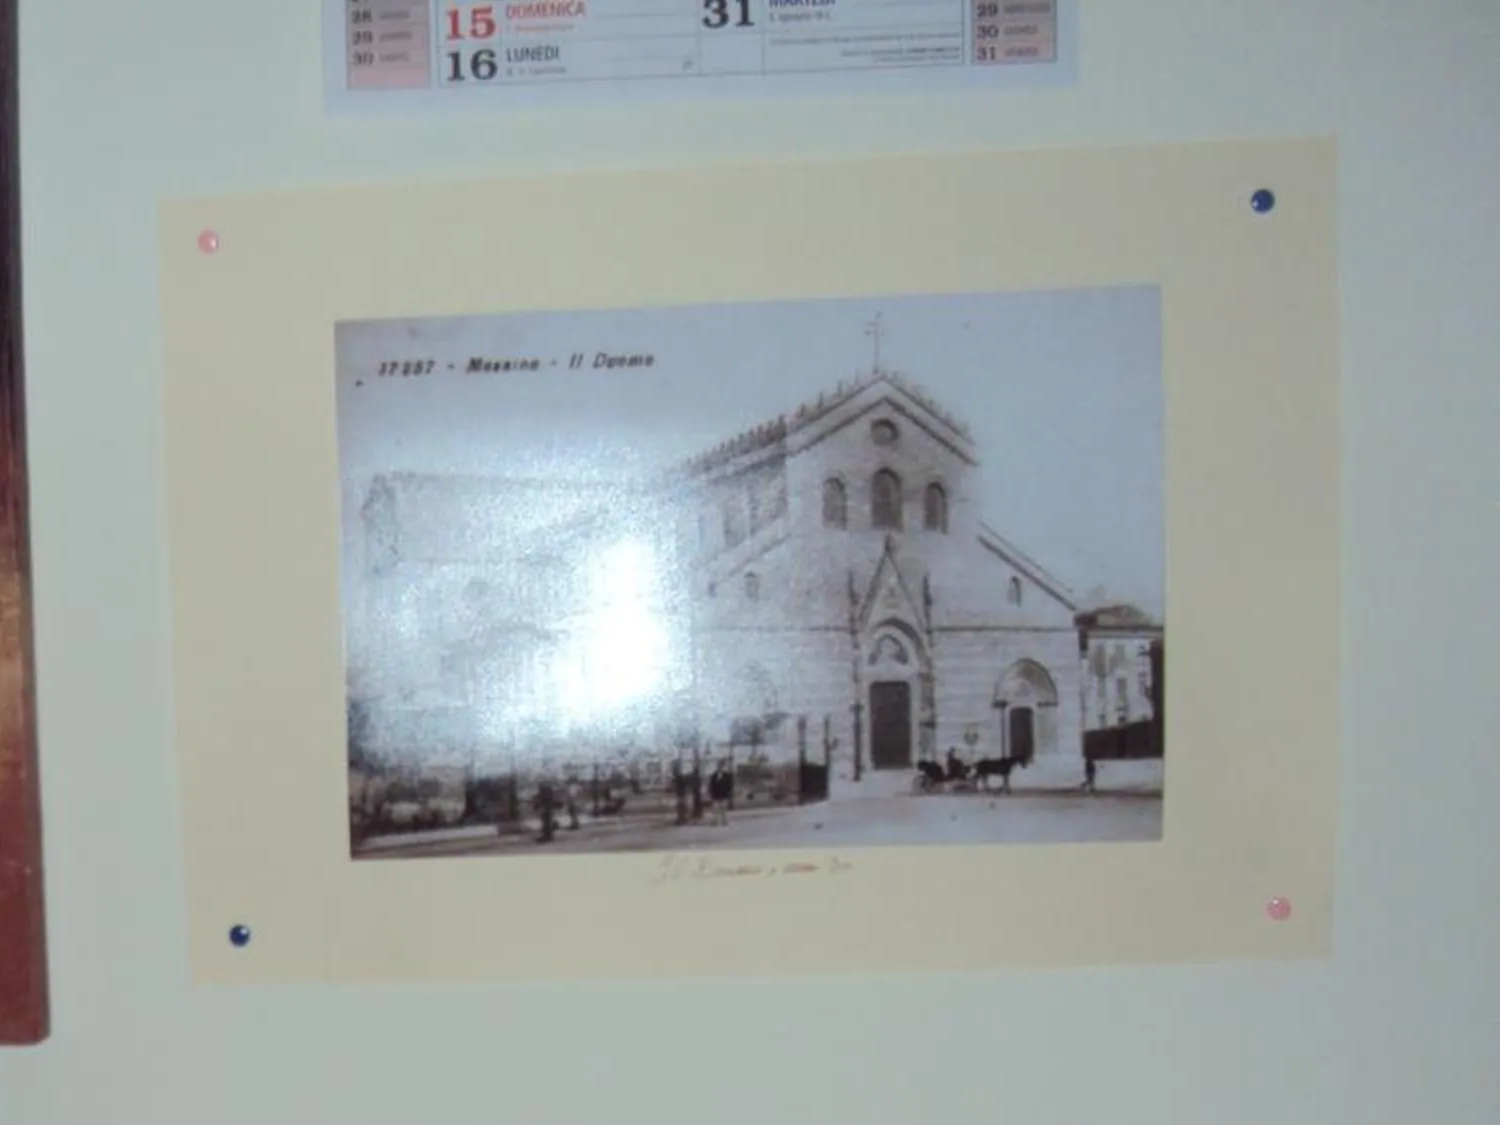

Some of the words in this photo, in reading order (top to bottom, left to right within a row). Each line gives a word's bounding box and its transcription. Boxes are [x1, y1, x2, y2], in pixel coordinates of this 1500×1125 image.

[446, 7, 496, 41] 15
[701, 0, 755, 28] 31
[447, 49, 498, 81] 16
